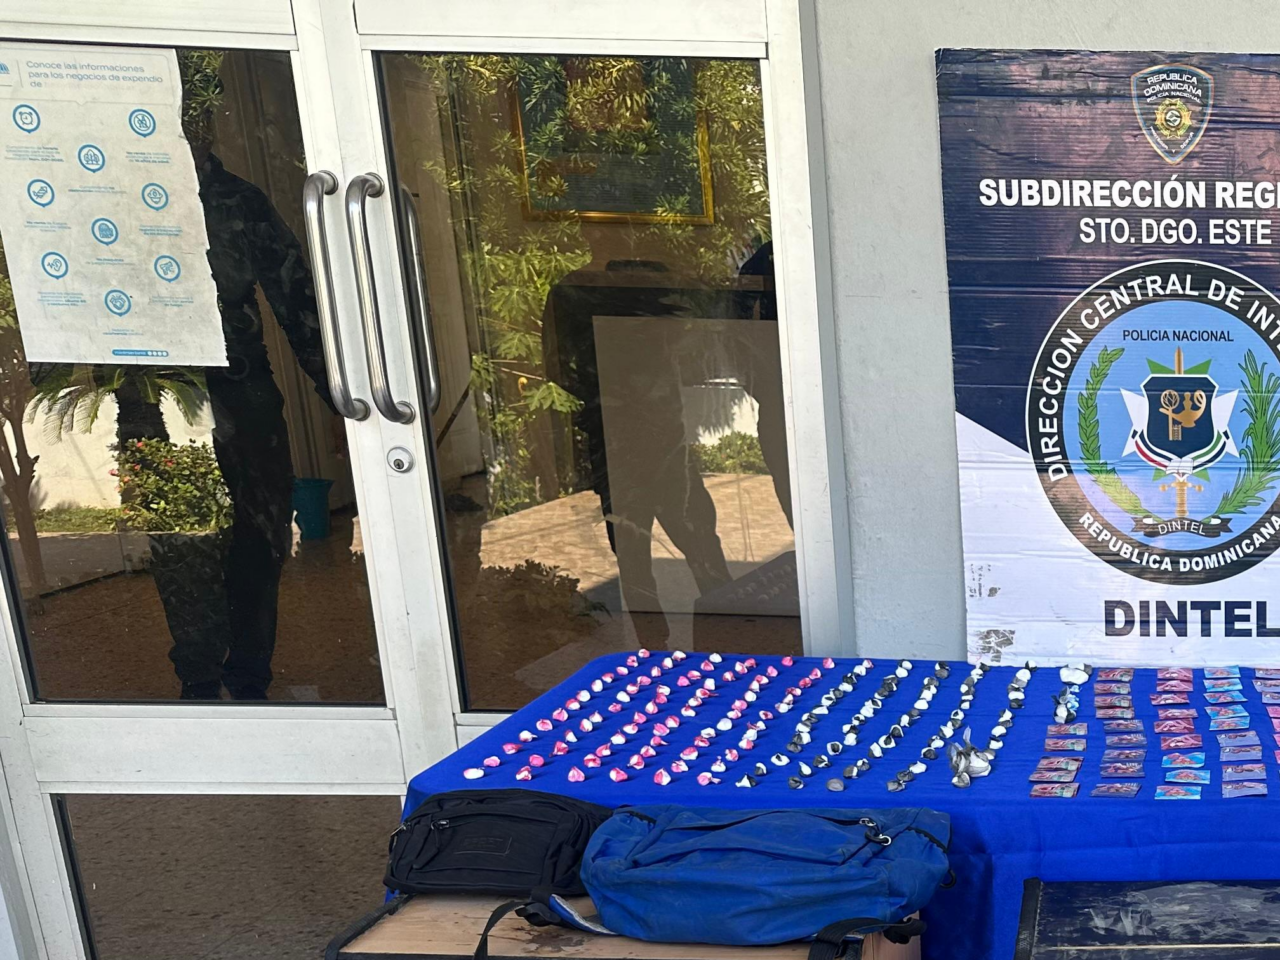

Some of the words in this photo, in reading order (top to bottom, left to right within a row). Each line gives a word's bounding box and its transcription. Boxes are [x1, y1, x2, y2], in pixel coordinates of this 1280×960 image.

[26, 60, 62, 70] Conoce
[64, 61, 78, 70] las
[80, 62, 144, 73] informaciones
[28, 71, 48, 80] para
[50, 71, 64, 79] los
[66, 73, 107, 82] negocios
[122, 75, 163, 83] expendio
[1143, 82, 1202, 97] DOMINICANA
[979, 174, 1206, 208] SUBDIRECCIÓN
[1079, 217, 1136, 244] STO.
[1141, 218, 1203, 245] DGO.
[1209, 219, 1273, 245] ESTE
[1080, 273, 1200, 330] CENTRAL
[1207, 278, 1246, 311] DE
[1122, 329, 1170, 342] POLICIA
[1172, 330, 1235, 343] NACIONAL
[1157, 520, 1207, 536] DINTEL
[1078, 511, 1174, 573] REPUBLICA
